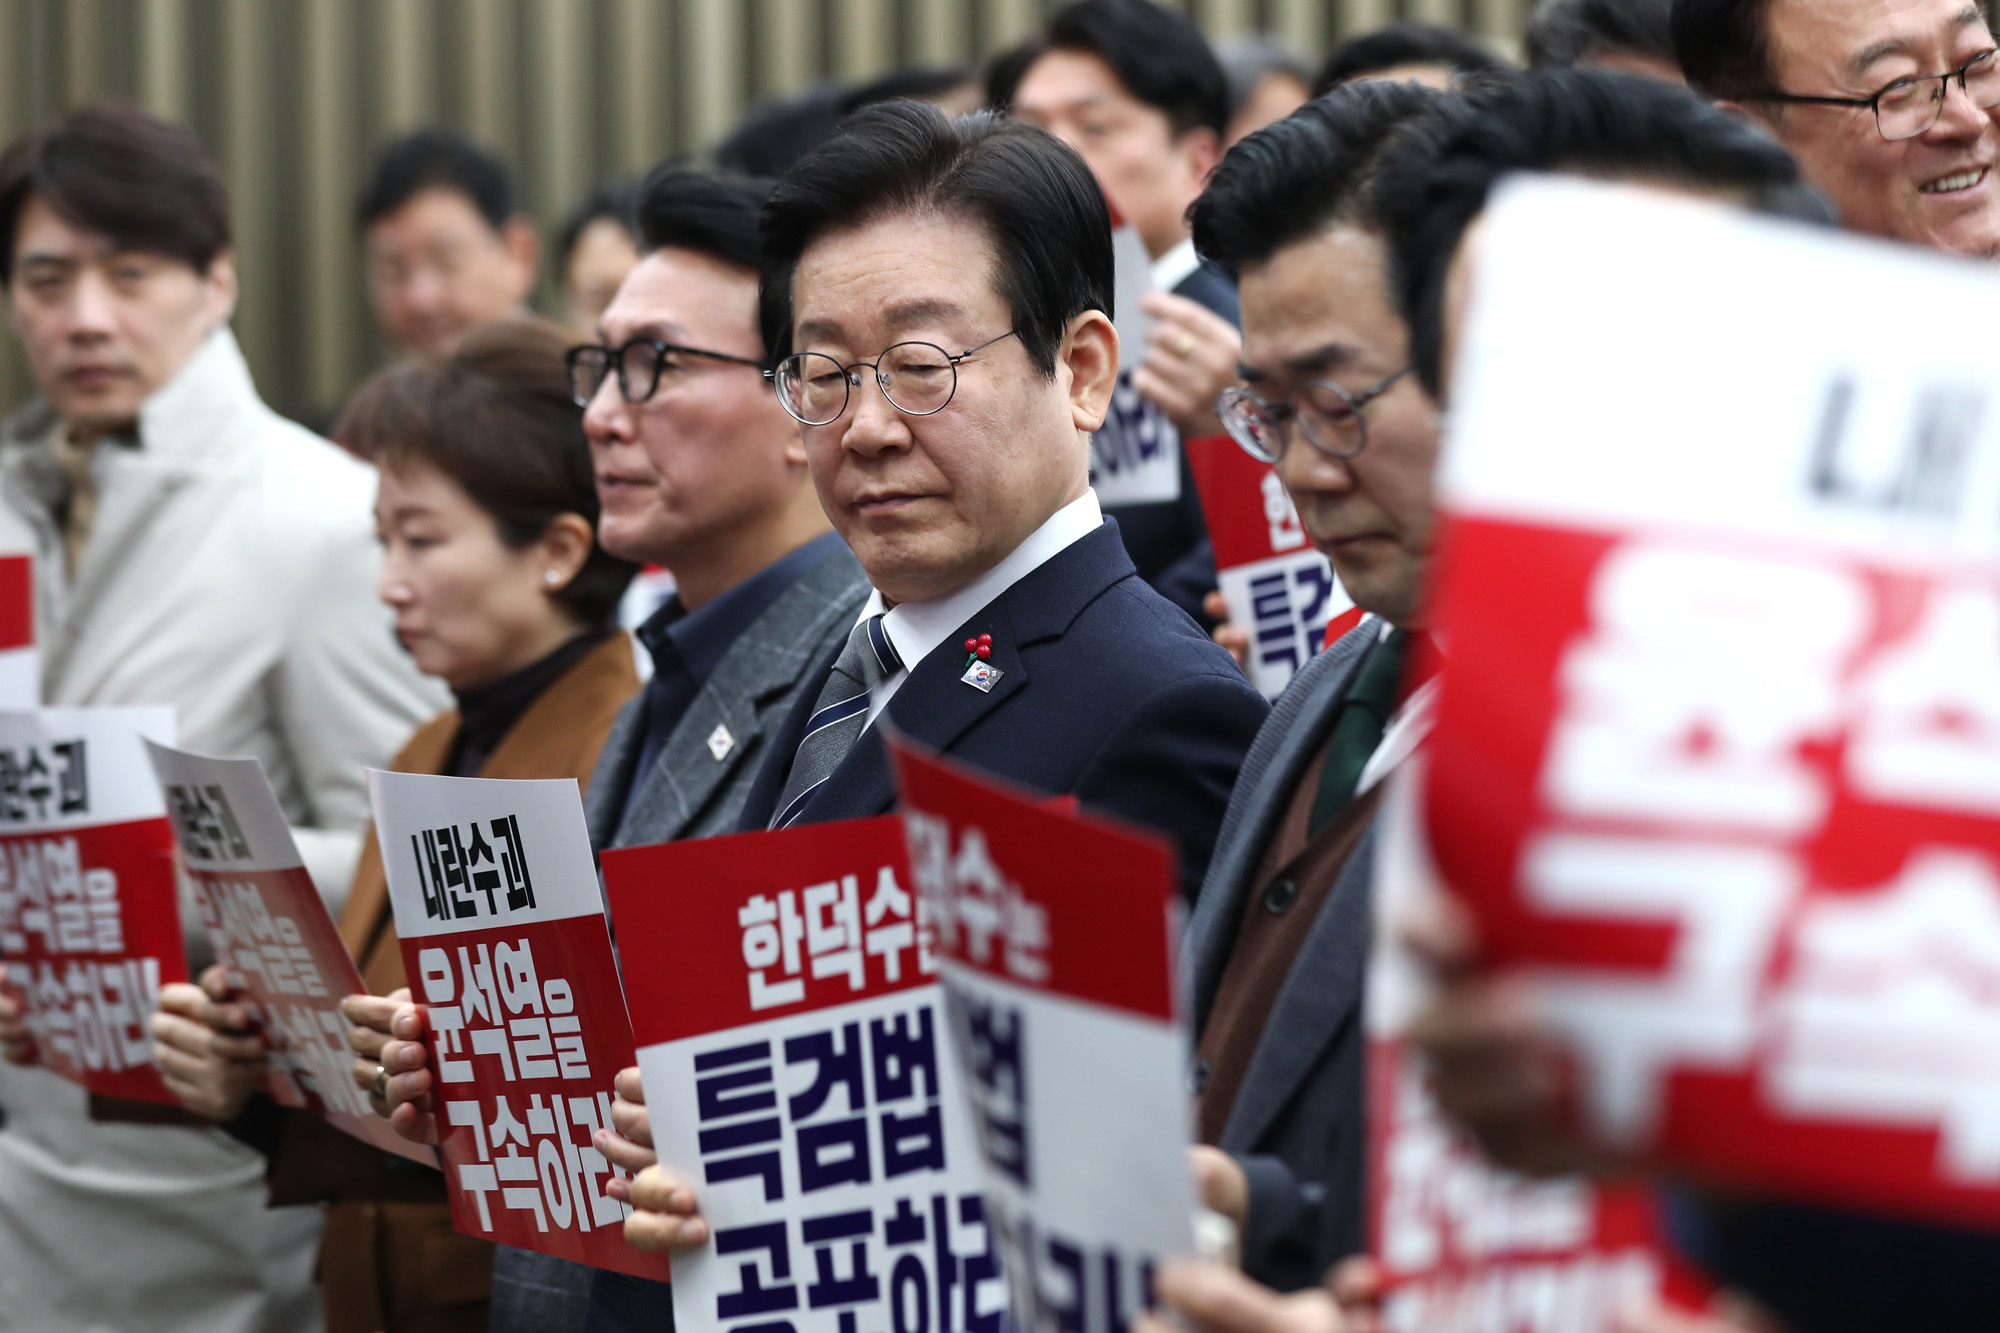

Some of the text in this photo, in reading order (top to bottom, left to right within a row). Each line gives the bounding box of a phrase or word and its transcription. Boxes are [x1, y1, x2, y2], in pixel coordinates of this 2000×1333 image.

[411, 814, 537, 921] 내란수괴
[419, 938, 591, 1084] 윤석열을
[446, 1090, 635, 1234] 구속하라
[693, 1005, 947, 1202] 특검법
